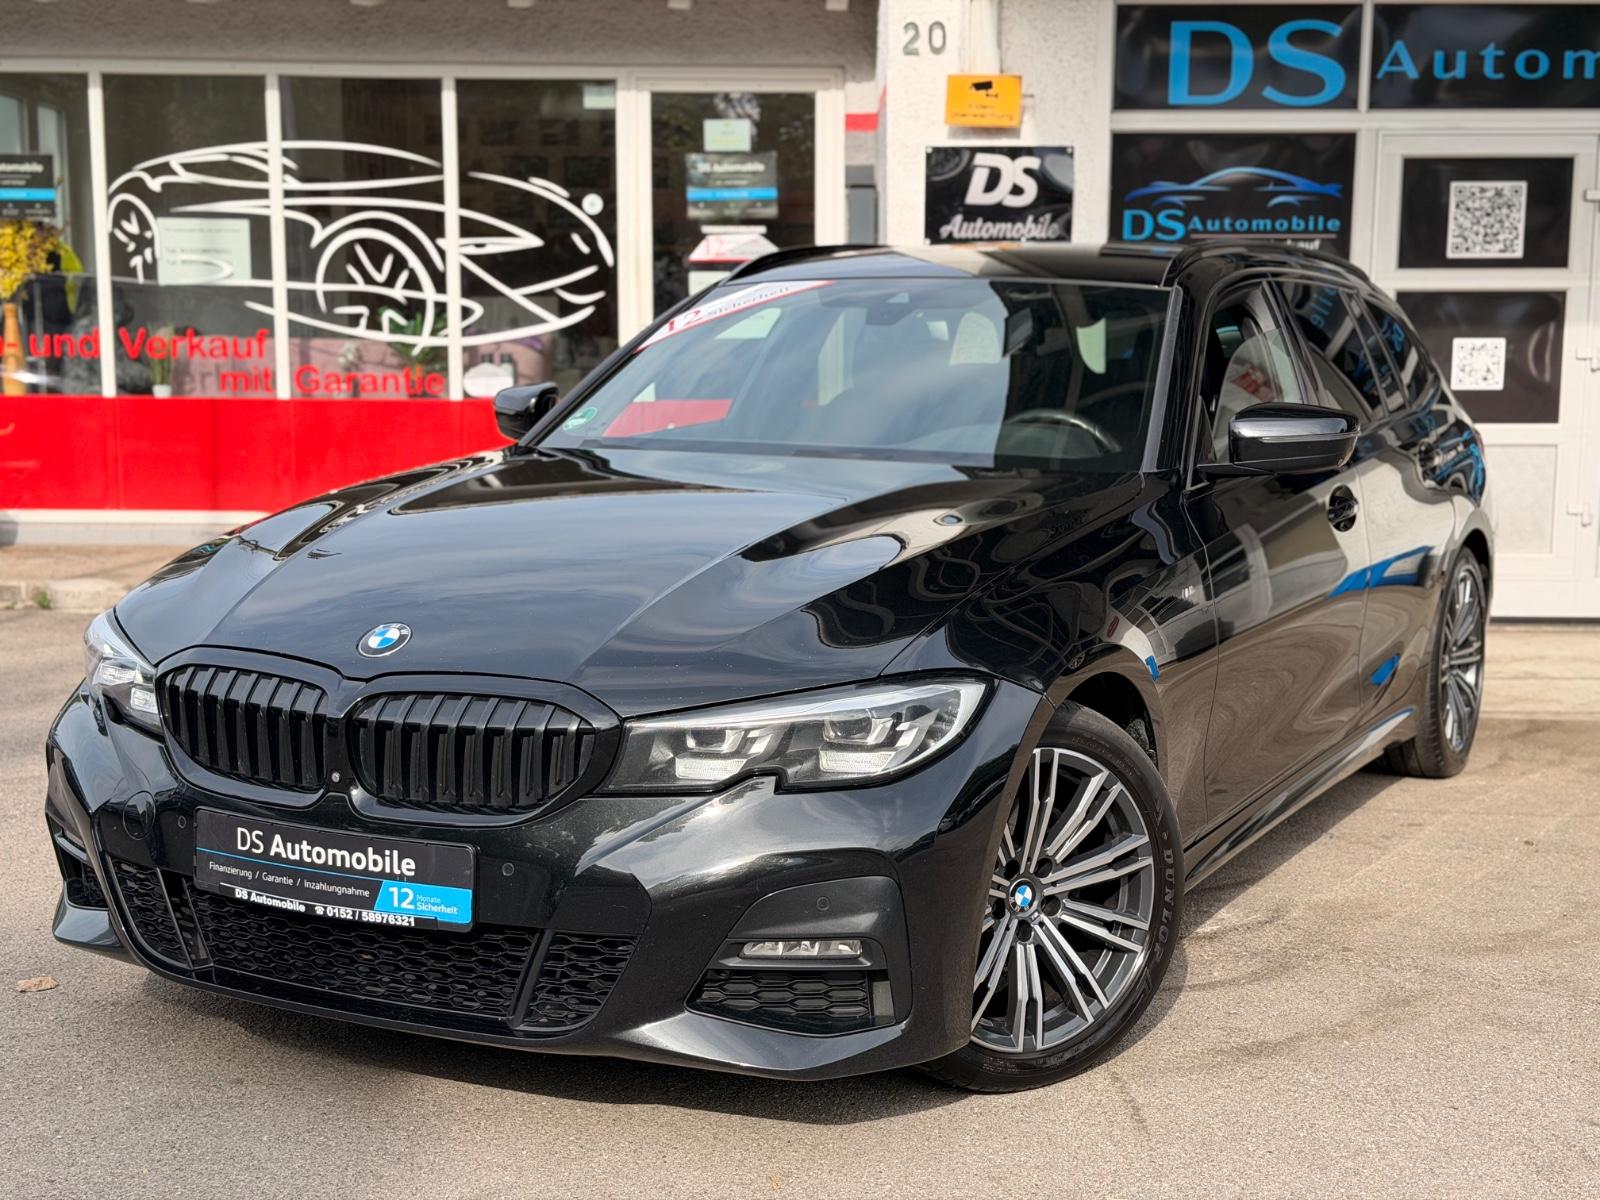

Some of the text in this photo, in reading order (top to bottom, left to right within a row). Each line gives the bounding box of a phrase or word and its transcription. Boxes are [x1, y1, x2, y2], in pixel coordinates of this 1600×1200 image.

[902, 21, 947, 56] 20
[1168, 18, 1347, 107] DS
[964, 153, 1042, 206] DS
[939, 214, 1060, 243] Automobile
[1121, 208, 1341, 241] DS Automobile
[28, 327, 100, 359] und
[118, 327, 272, 360] Verkauf
[219, 367, 276, 393] mit
[294, 365, 446, 395] Garantie
[236, 827, 416, 876] DS Automobile
[209, 861, 252, 880] Finanzierung
[262, 871, 294, 886] Garantie
[304, 879, 370, 898] Inzahlungnahme
[234, 888, 248, 900] DS
[250, 891, 306, 912] Automobile
[326, 906, 354, 920] 0152
[361, 911, 415, 927] 58976321
[388, 886, 415, 910] 12
[416, 902, 458, 915] Sicherheit
[1154, 847, 1176, 967] DUNLOP
